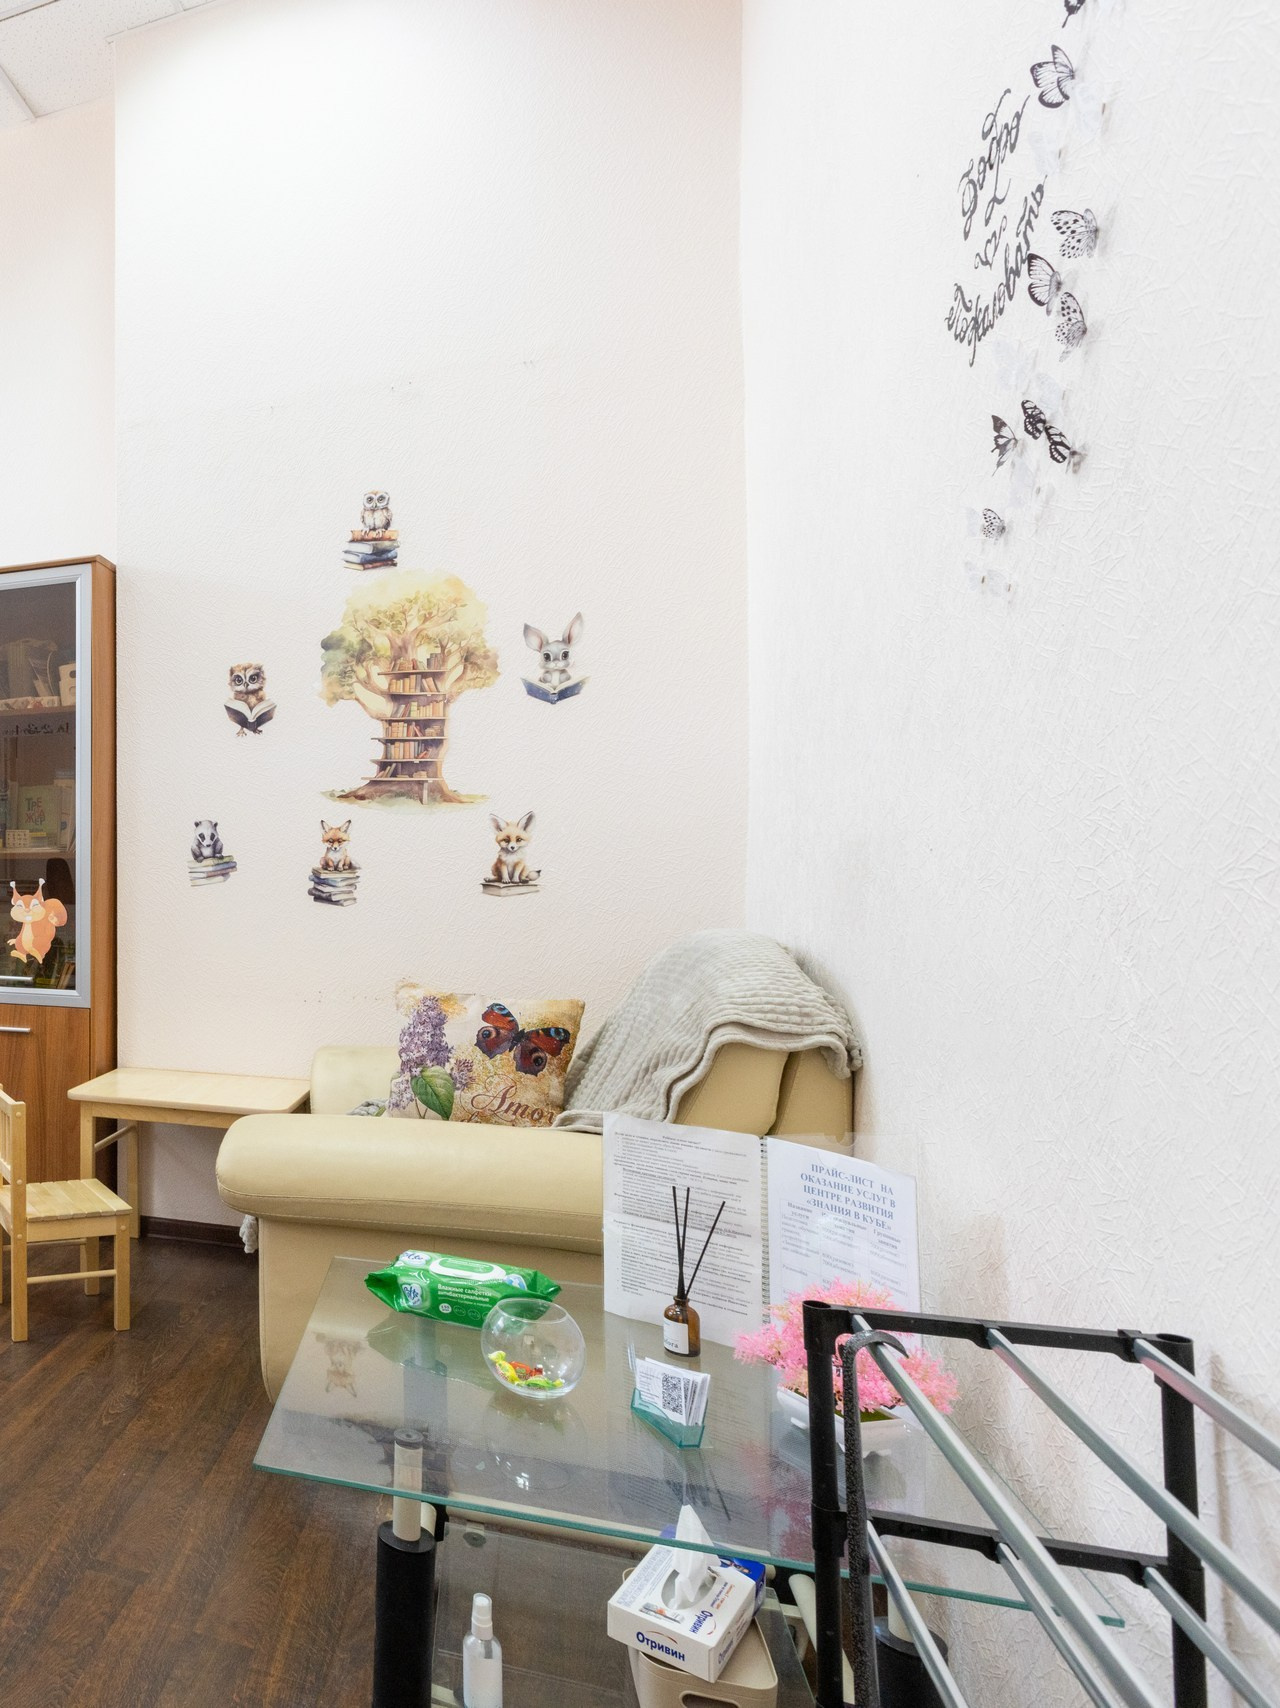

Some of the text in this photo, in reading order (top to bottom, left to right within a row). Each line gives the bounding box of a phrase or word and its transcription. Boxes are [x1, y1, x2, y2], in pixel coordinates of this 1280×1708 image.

[800, 1173, 896, 1208] ОКАЗАНИЕ УСЛУГ В
[811, 1163, 894, 1195] ПРАЙС-ЛИСТ НА
[803, 1185, 894, 1220] ЦЕНТРЕ РАЗВИТИЯ
[806, 1199, 891, 1231] «ЗНАНИЯ В КУБЕ»
[438, 1284, 492, 1296] Влажные салфетки
[438, 1291, 490, 1302] антибактериальные
[689, 1610, 713, 1635] Отривин
[636, 1631, 685, 1662] Отривин
